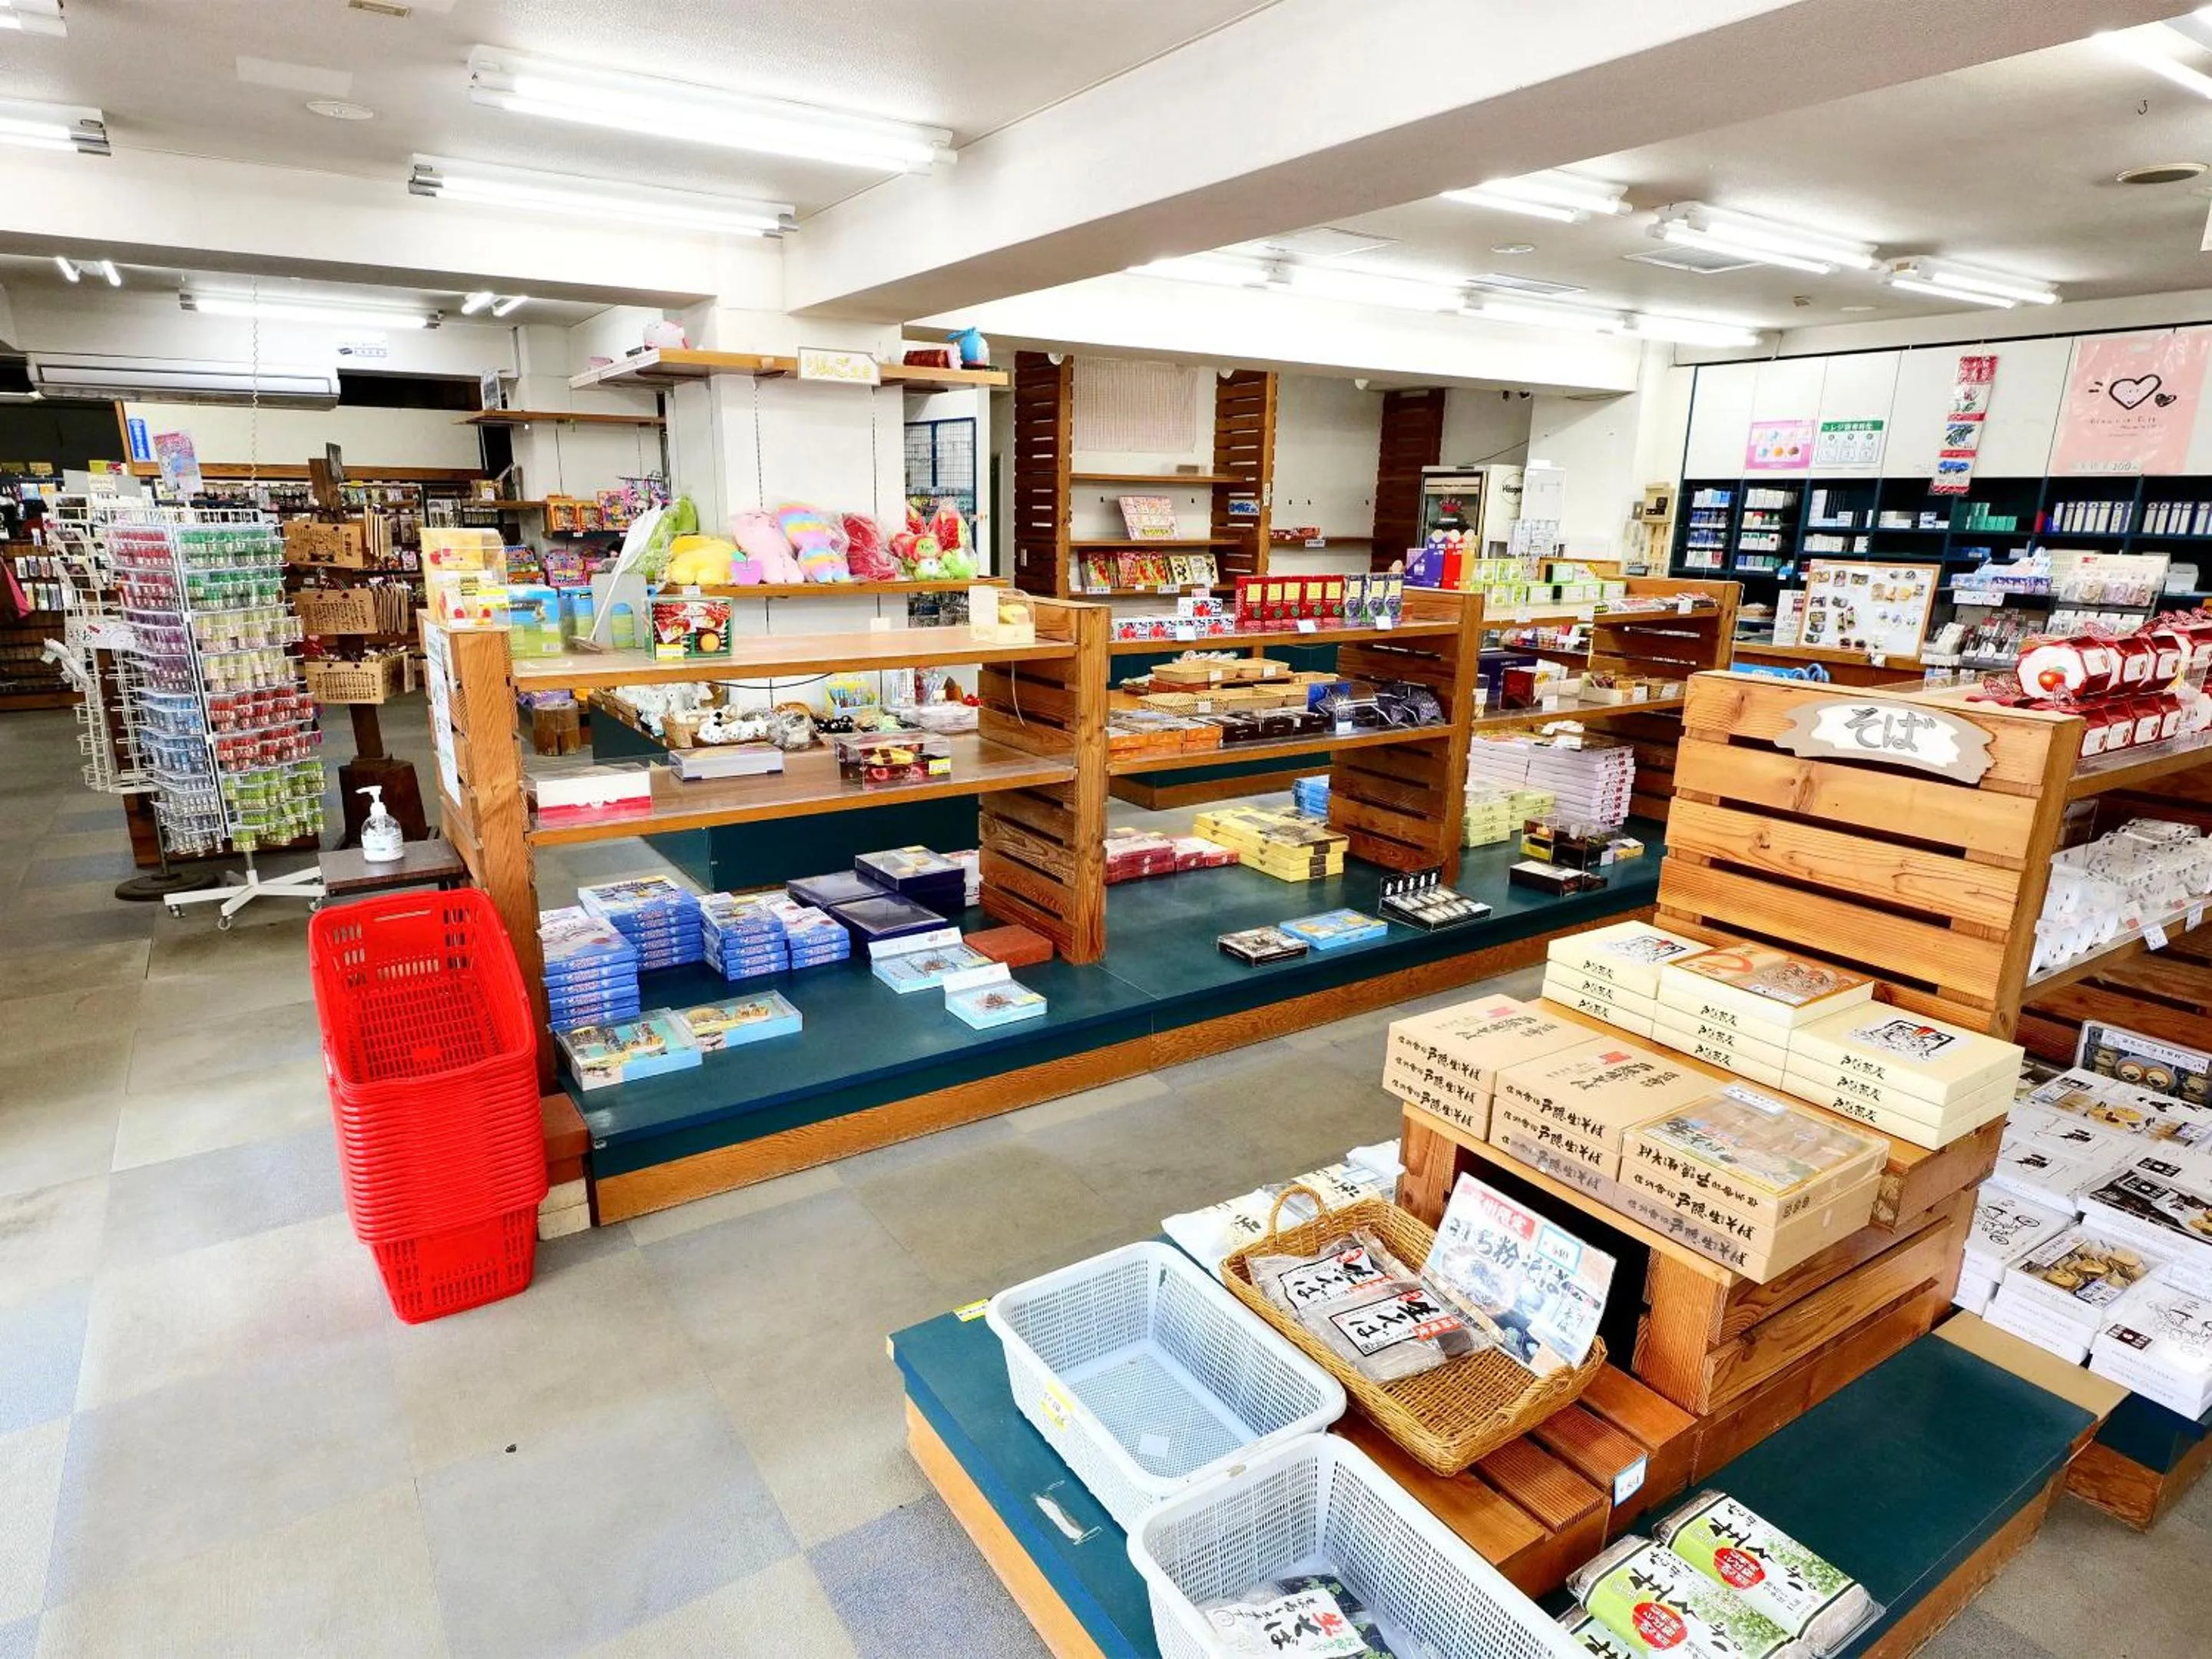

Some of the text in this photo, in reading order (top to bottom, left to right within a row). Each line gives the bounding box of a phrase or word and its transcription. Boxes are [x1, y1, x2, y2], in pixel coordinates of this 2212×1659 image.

[1845, 707, 1938, 753] そば
[1709, 1517, 1817, 1592] 生そば
[1629, 1567, 1743, 1652] 生そば
